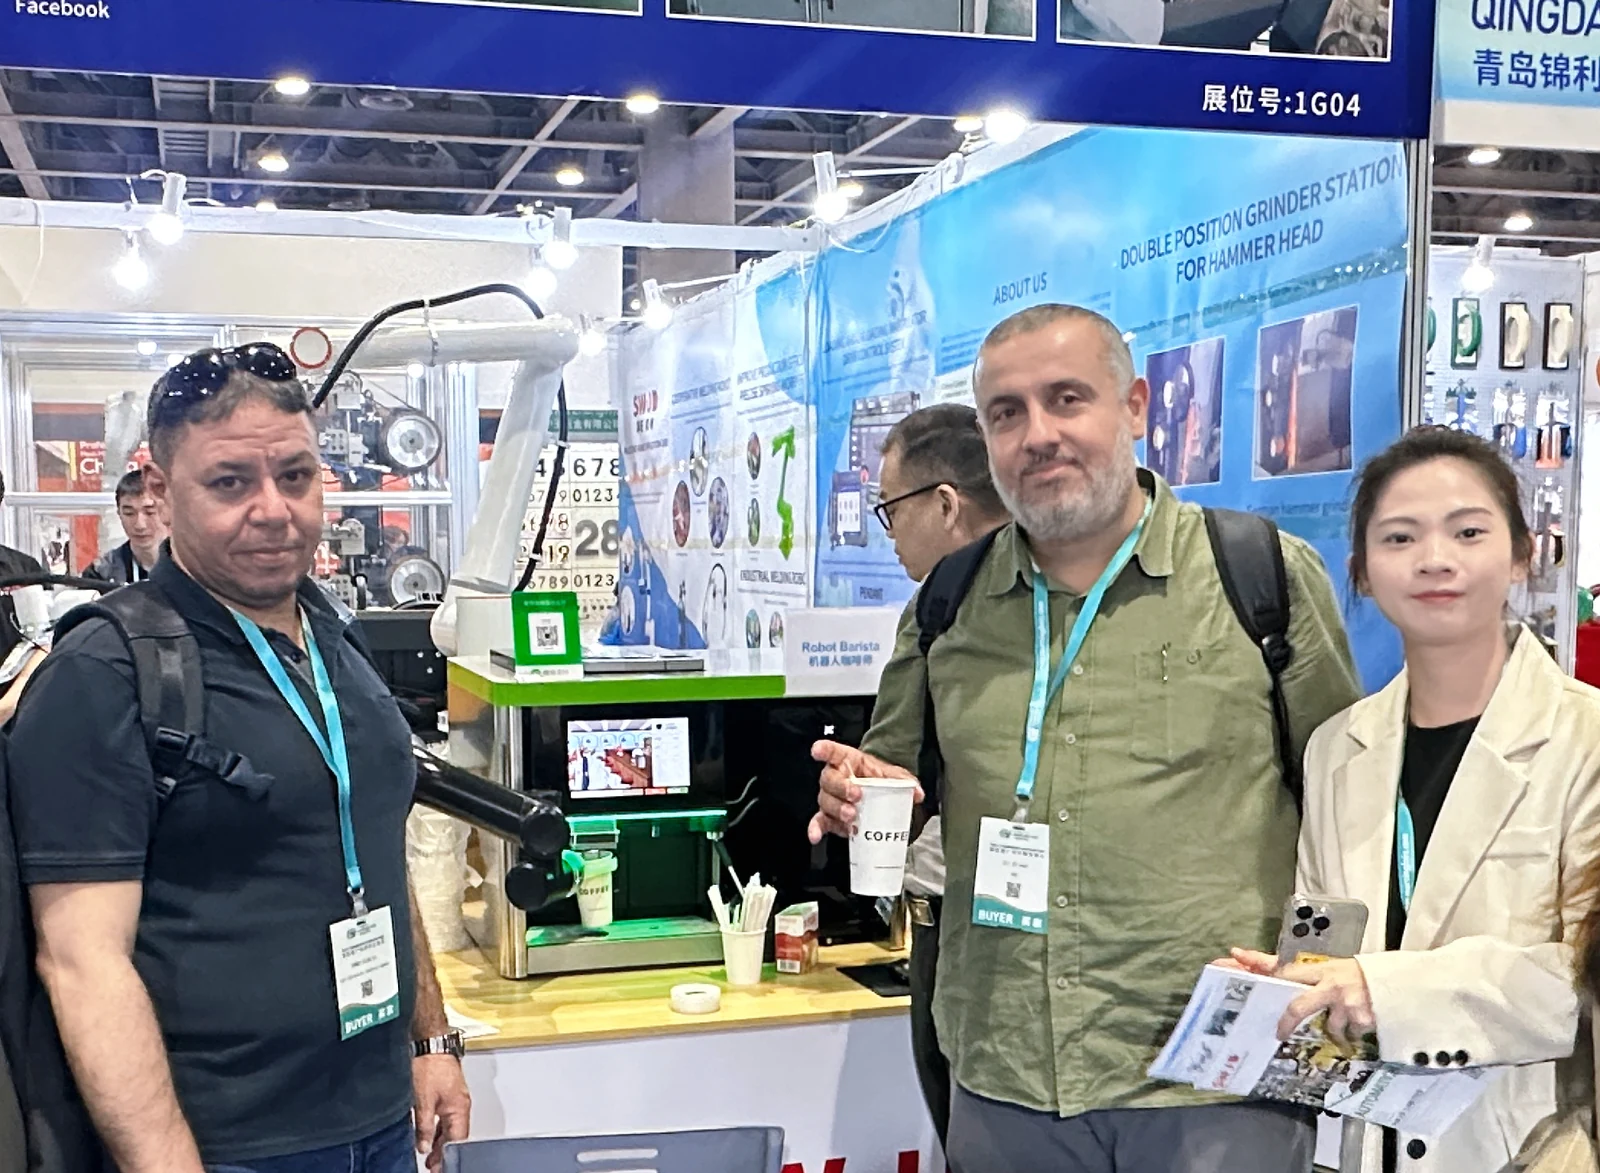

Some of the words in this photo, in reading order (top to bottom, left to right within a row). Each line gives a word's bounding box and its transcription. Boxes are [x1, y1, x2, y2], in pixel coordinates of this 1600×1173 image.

[15, 0, 110, 18] Facebook
[1473, 49, 1600, 93] 青岛锦利
[1202, 84, 1361, 117] 展位号:1G04
[1120, 231, 1173, 269] DOUBLE
[1175, 207, 1244, 252] POSITION
[1246, 181, 1322, 228] GRINDER
[1324, 153, 1404, 204] STATION
[1176, 255, 1207, 284] FOR
[1208, 233, 1276, 275] HAMMER
[1278, 218, 1325, 255] HEAD
[993, 277, 1031, 306] ABOUT
[1032, 272, 1048, 294] US
[575, 519, 619, 556] 28
[802, 641, 836, 653] Robot
[839, 640, 880, 652] Barista
[978, 909, 1014, 925] BUYER
